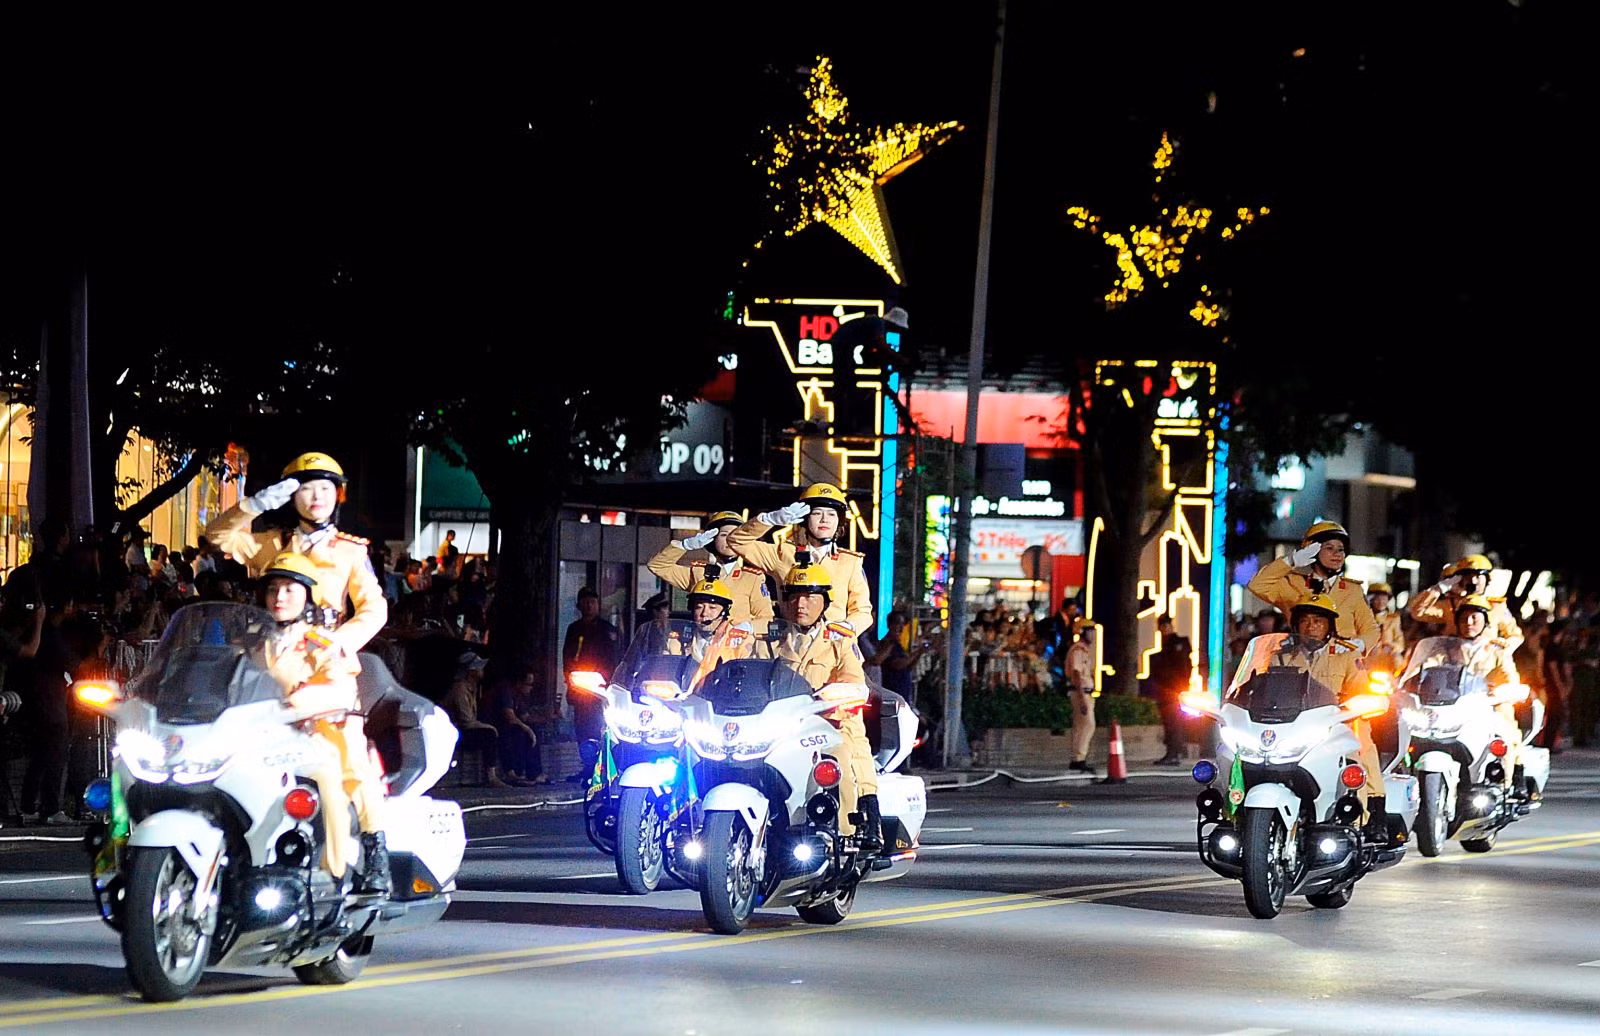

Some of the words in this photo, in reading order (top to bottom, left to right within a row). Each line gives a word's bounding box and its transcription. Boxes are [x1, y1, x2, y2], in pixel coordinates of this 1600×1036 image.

[800, 315, 839, 340] HD
[693, 444, 724, 475] 09
[799, 734, 829, 748] CSGT
